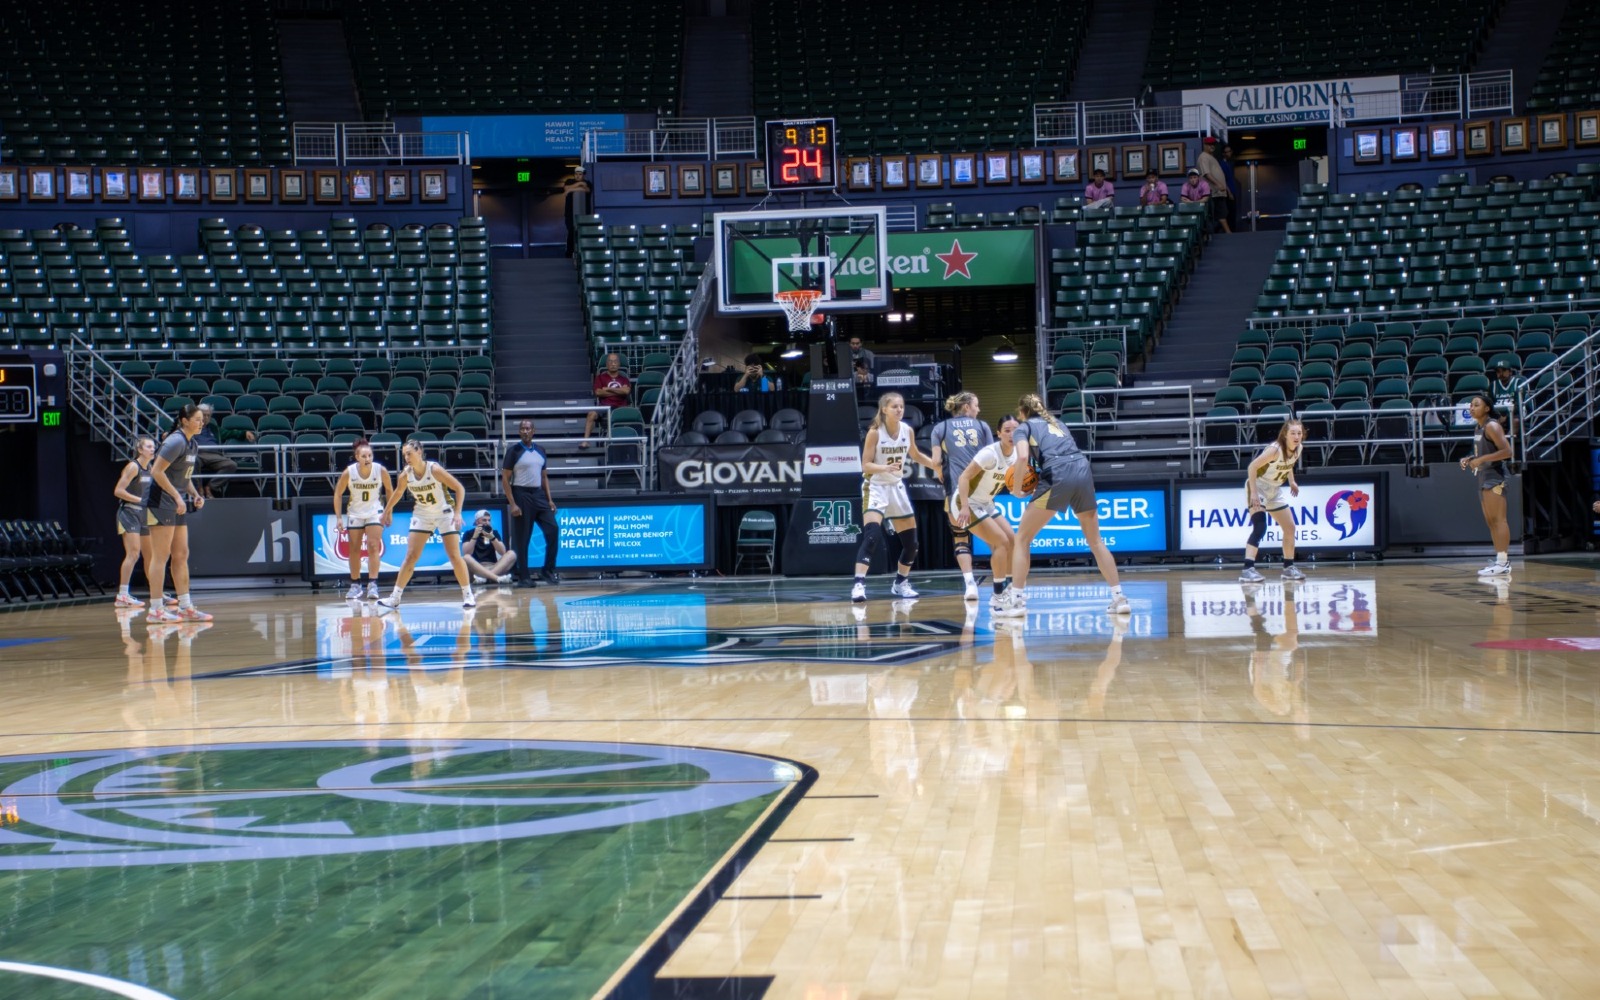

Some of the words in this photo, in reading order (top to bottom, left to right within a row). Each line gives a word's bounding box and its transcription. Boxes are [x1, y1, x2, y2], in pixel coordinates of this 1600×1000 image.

[1226, 81, 1354, 111] CALIFORNIA
[1229, 115, 1257, 126] HOTEL
[1264, 112, 1297, 123] CASINO
[1304, 111, 1320, 120] LAS
[1294, 139, 1306, 149] EXIT
[782, 148, 822, 181] 24
[517, 172, 530, 182] EXIT
[43, 412, 60, 426] EXIT
[953, 428, 978, 447] 33
[881, 446, 907, 454] VERMONT
[362, 491, 369, 501] 0
[416, 492, 437, 505] 24
[813, 500, 852, 529] 30
[560, 527, 604, 537] PACIFIC
[560, 539, 605, 549] HEALTH
[1067, 537, 1074, 546] &
